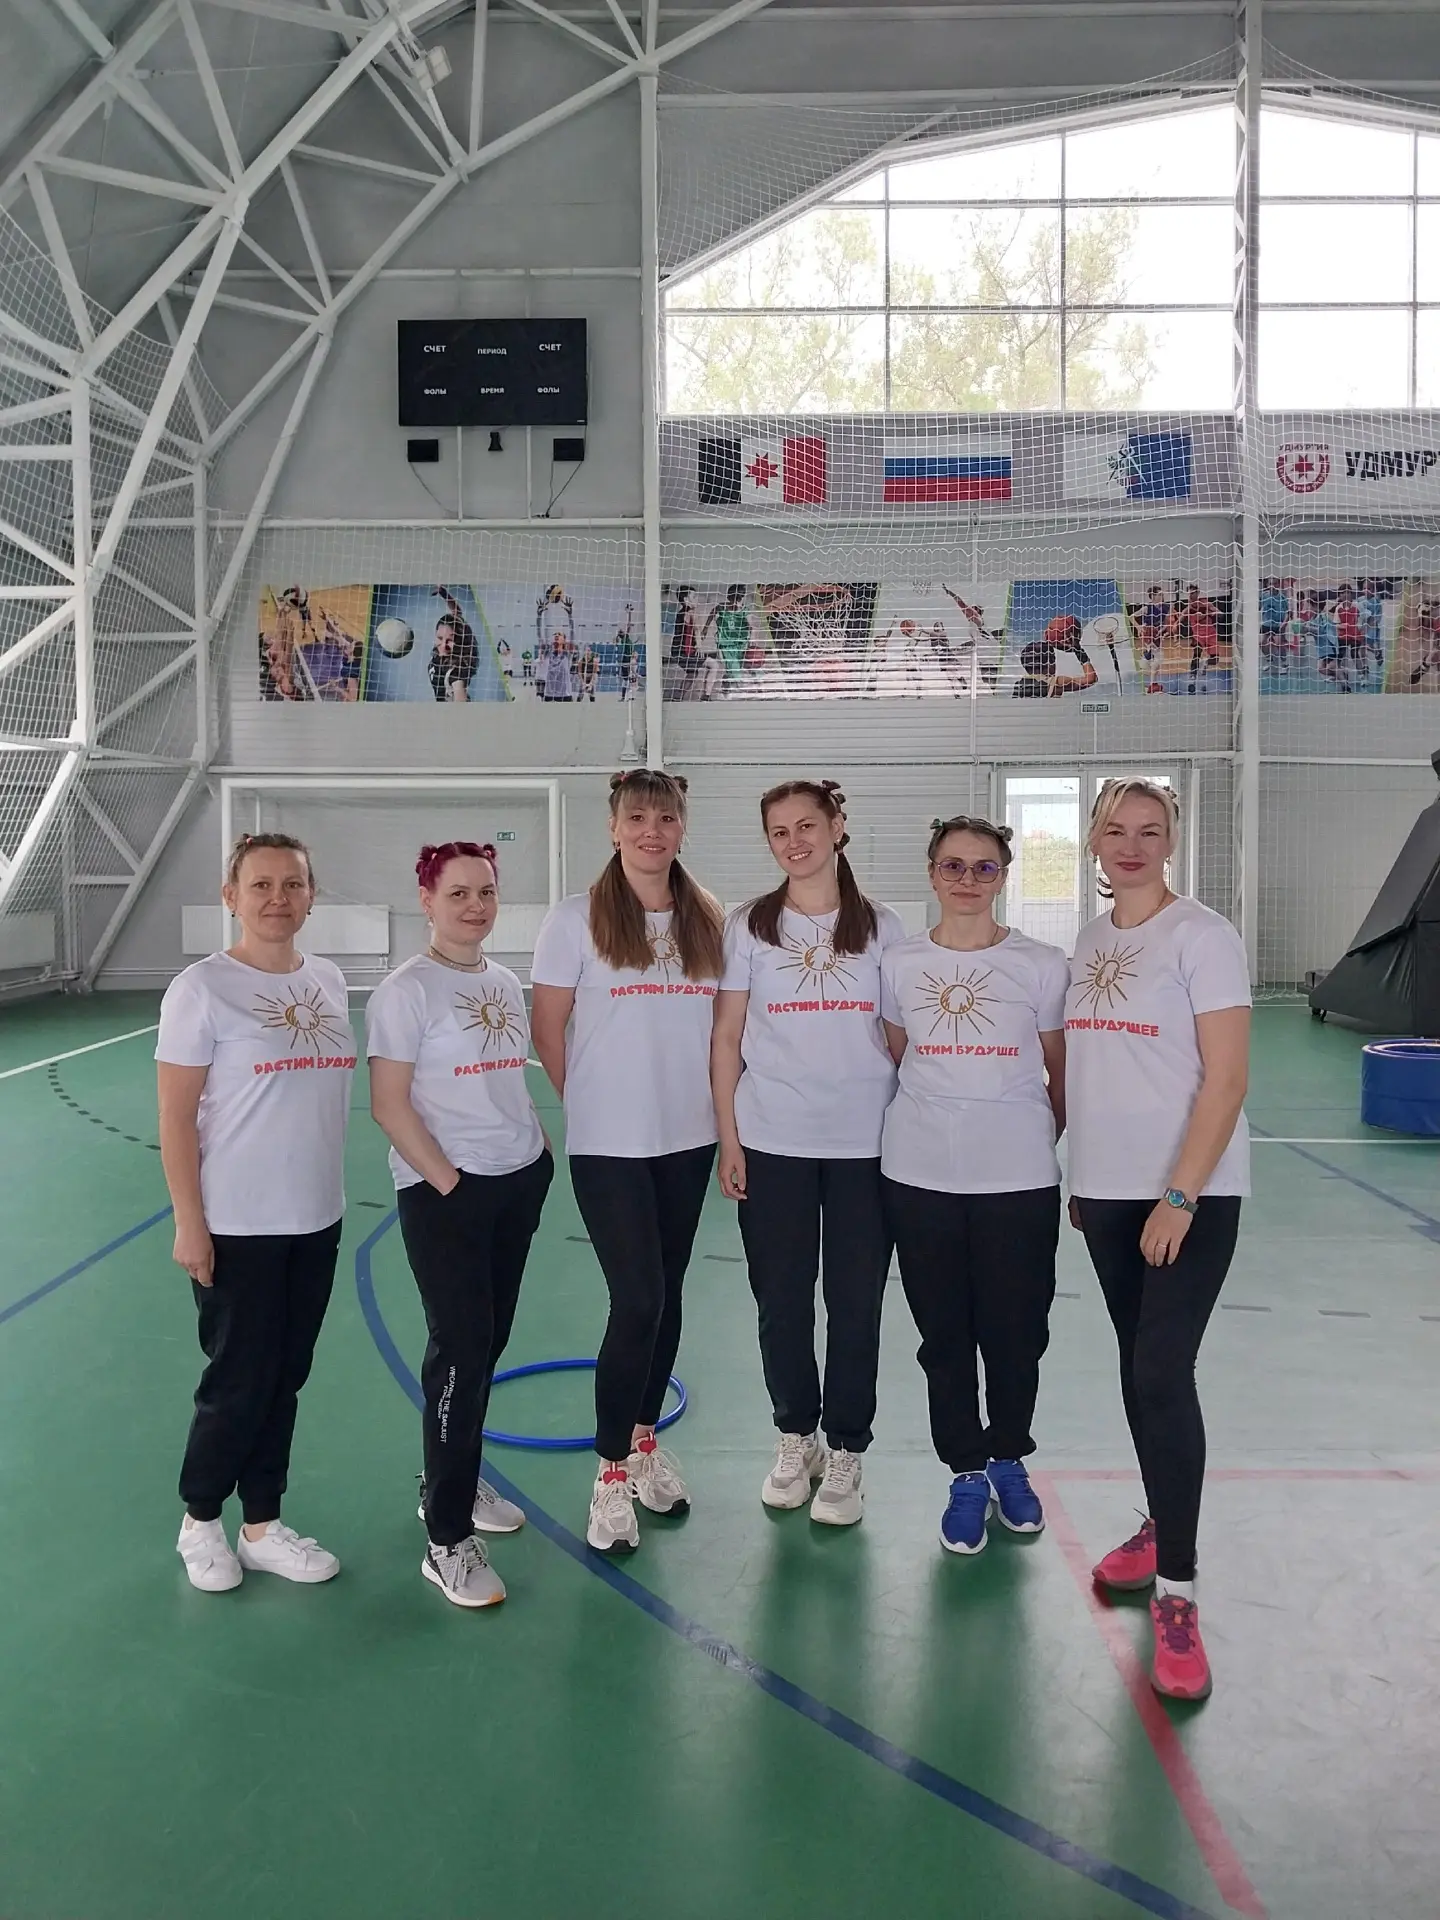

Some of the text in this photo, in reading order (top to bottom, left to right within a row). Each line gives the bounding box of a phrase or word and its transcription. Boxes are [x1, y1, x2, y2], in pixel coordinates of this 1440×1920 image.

[423, 345, 447, 353] СЧЕТ
[477, 347, 507, 356] ПЕРИОД
[538, 343, 562, 352] СЧЕТ
[1345, 451, 1440, 481] УДМУР
[610, 983, 665, 998] РАСТИМ
[767, 1000, 820, 1014] РАСТИМ
[1064, 1018, 1159, 1037] СТИМ БУДУЩЕЕ
[956, 1045, 1019, 1056] БУДУЩЕЕ
[254, 1056, 315, 1075] РАСТИМ
[454, 1057, 527, 1077] РАСТИМ БУДУ
